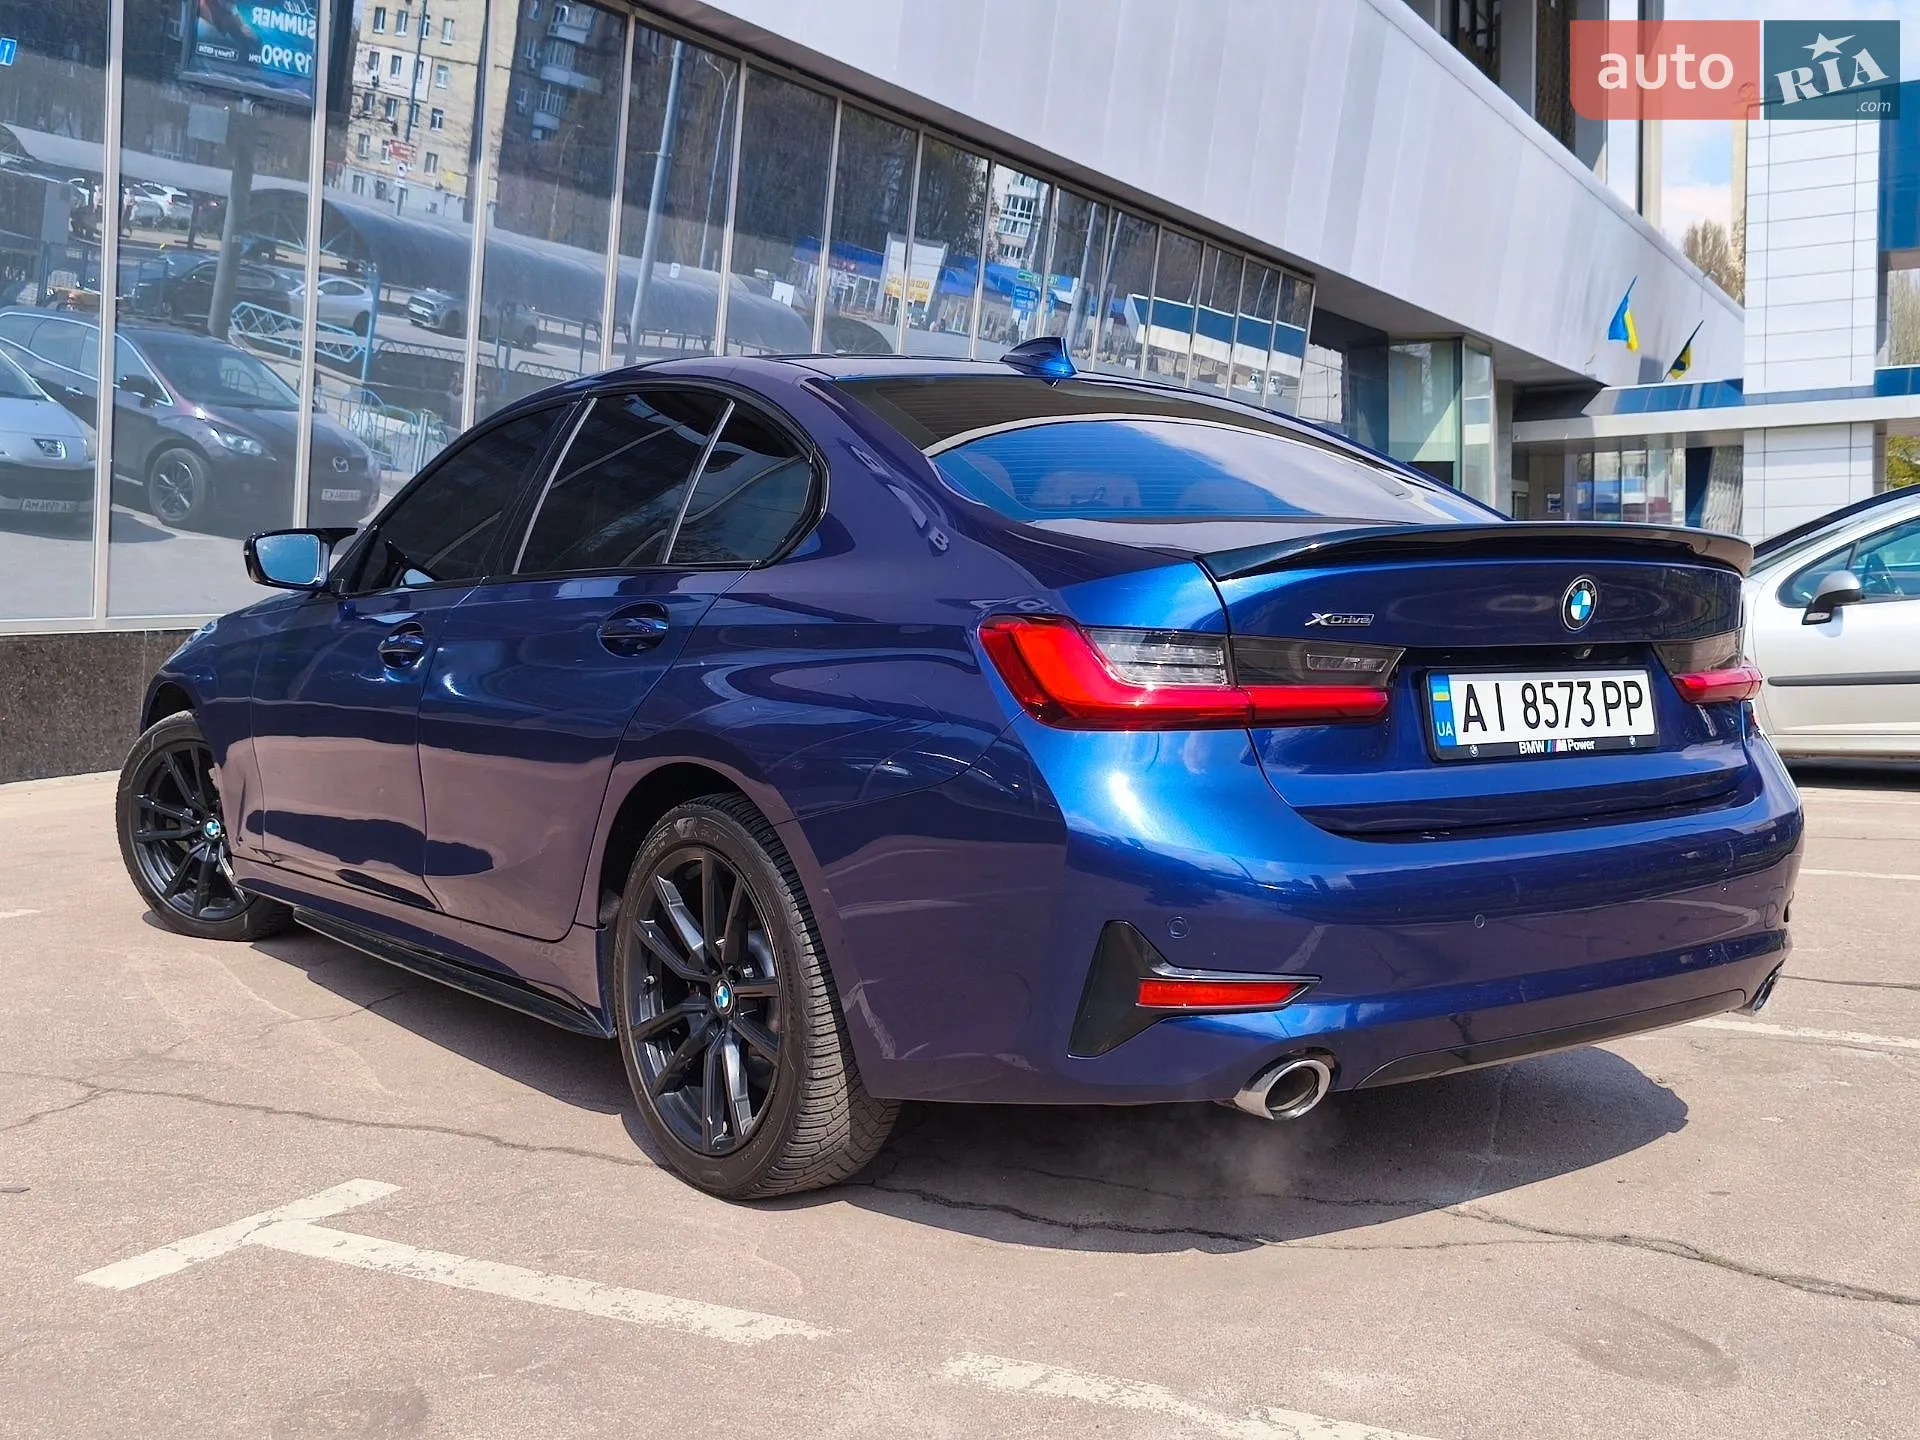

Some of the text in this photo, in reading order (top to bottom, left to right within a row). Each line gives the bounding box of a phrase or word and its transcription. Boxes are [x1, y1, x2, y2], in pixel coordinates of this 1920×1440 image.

[1462, 680, 1644, 733] AI 8573 PP
[1436, 721, 1454, 737] UA
[1518, 740, 1545, 755] BMW
[1567, 738, 1595, 751] Power
